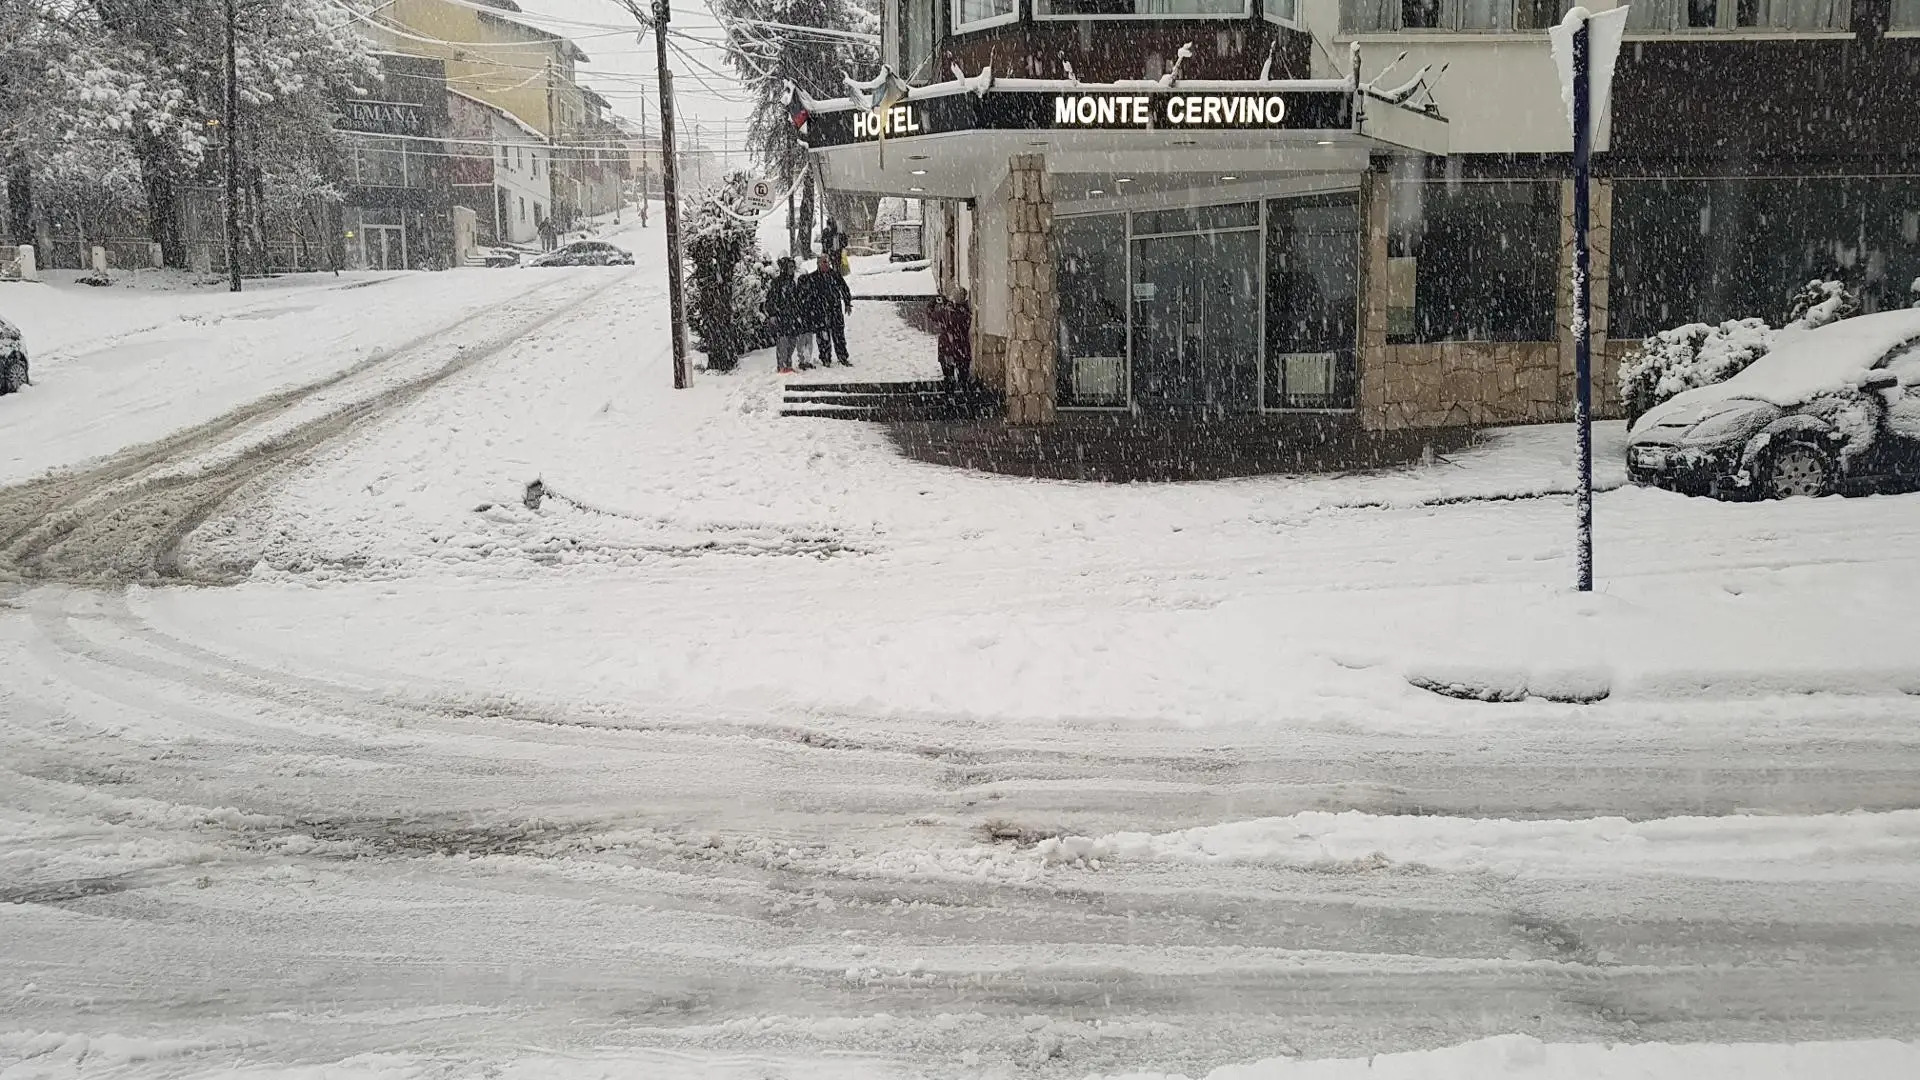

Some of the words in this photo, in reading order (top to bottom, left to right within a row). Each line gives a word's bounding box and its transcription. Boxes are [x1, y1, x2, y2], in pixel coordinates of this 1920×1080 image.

[853, 105, 920, 138] HOTEL
[1055, 95, 1150, 124] MONTE
[1167, 95, 1286, 124] CERVINO
